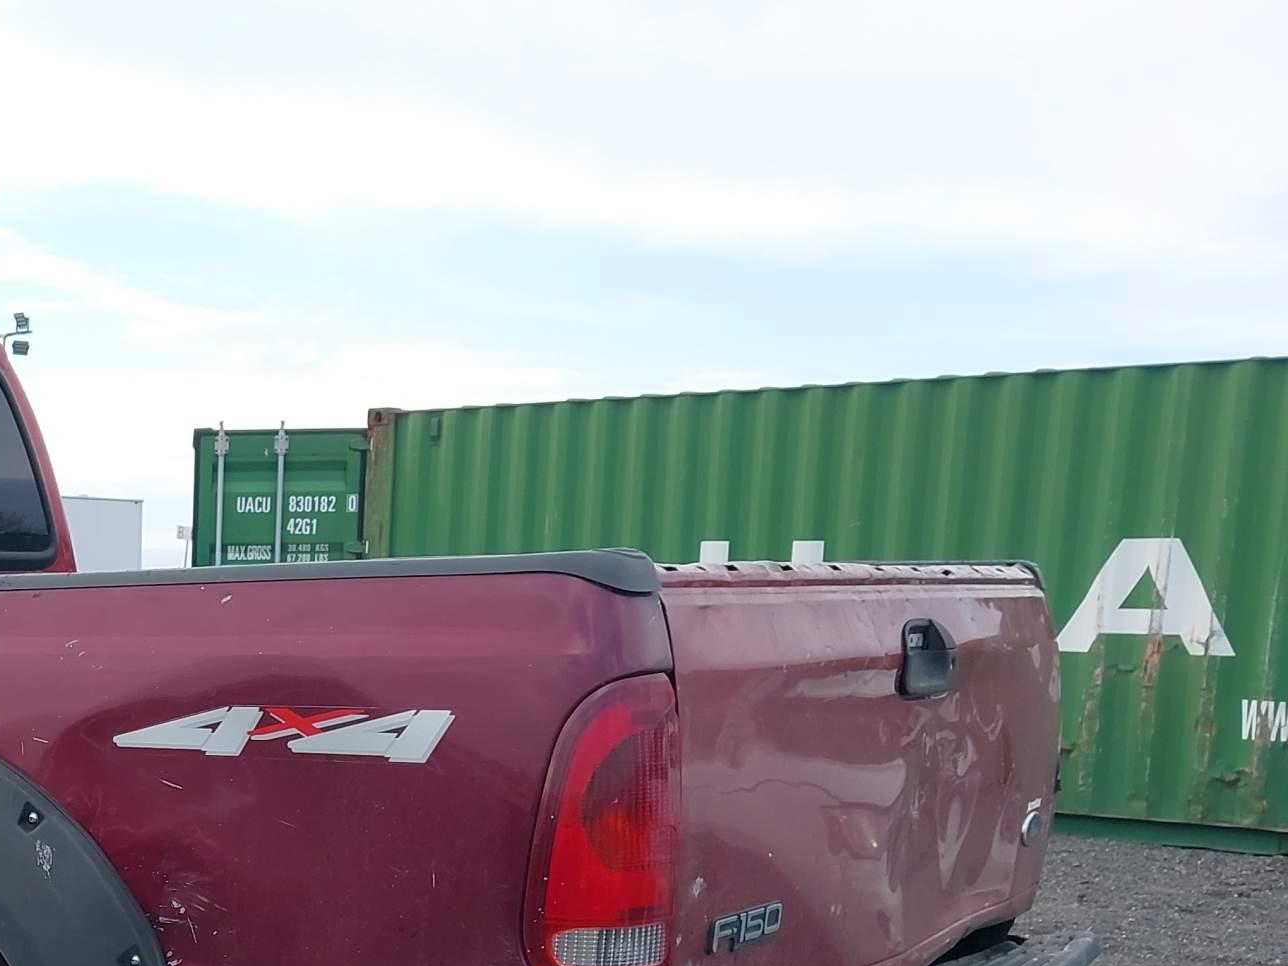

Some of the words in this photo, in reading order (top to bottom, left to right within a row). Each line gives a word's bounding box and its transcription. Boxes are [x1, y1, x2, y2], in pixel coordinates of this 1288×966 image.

[236, 496, 271, 513] UACU
[288, 496, 337, 512] 830182
[348, 494, 357, 512] 0
[286, 518, 317, 535] 42G1
